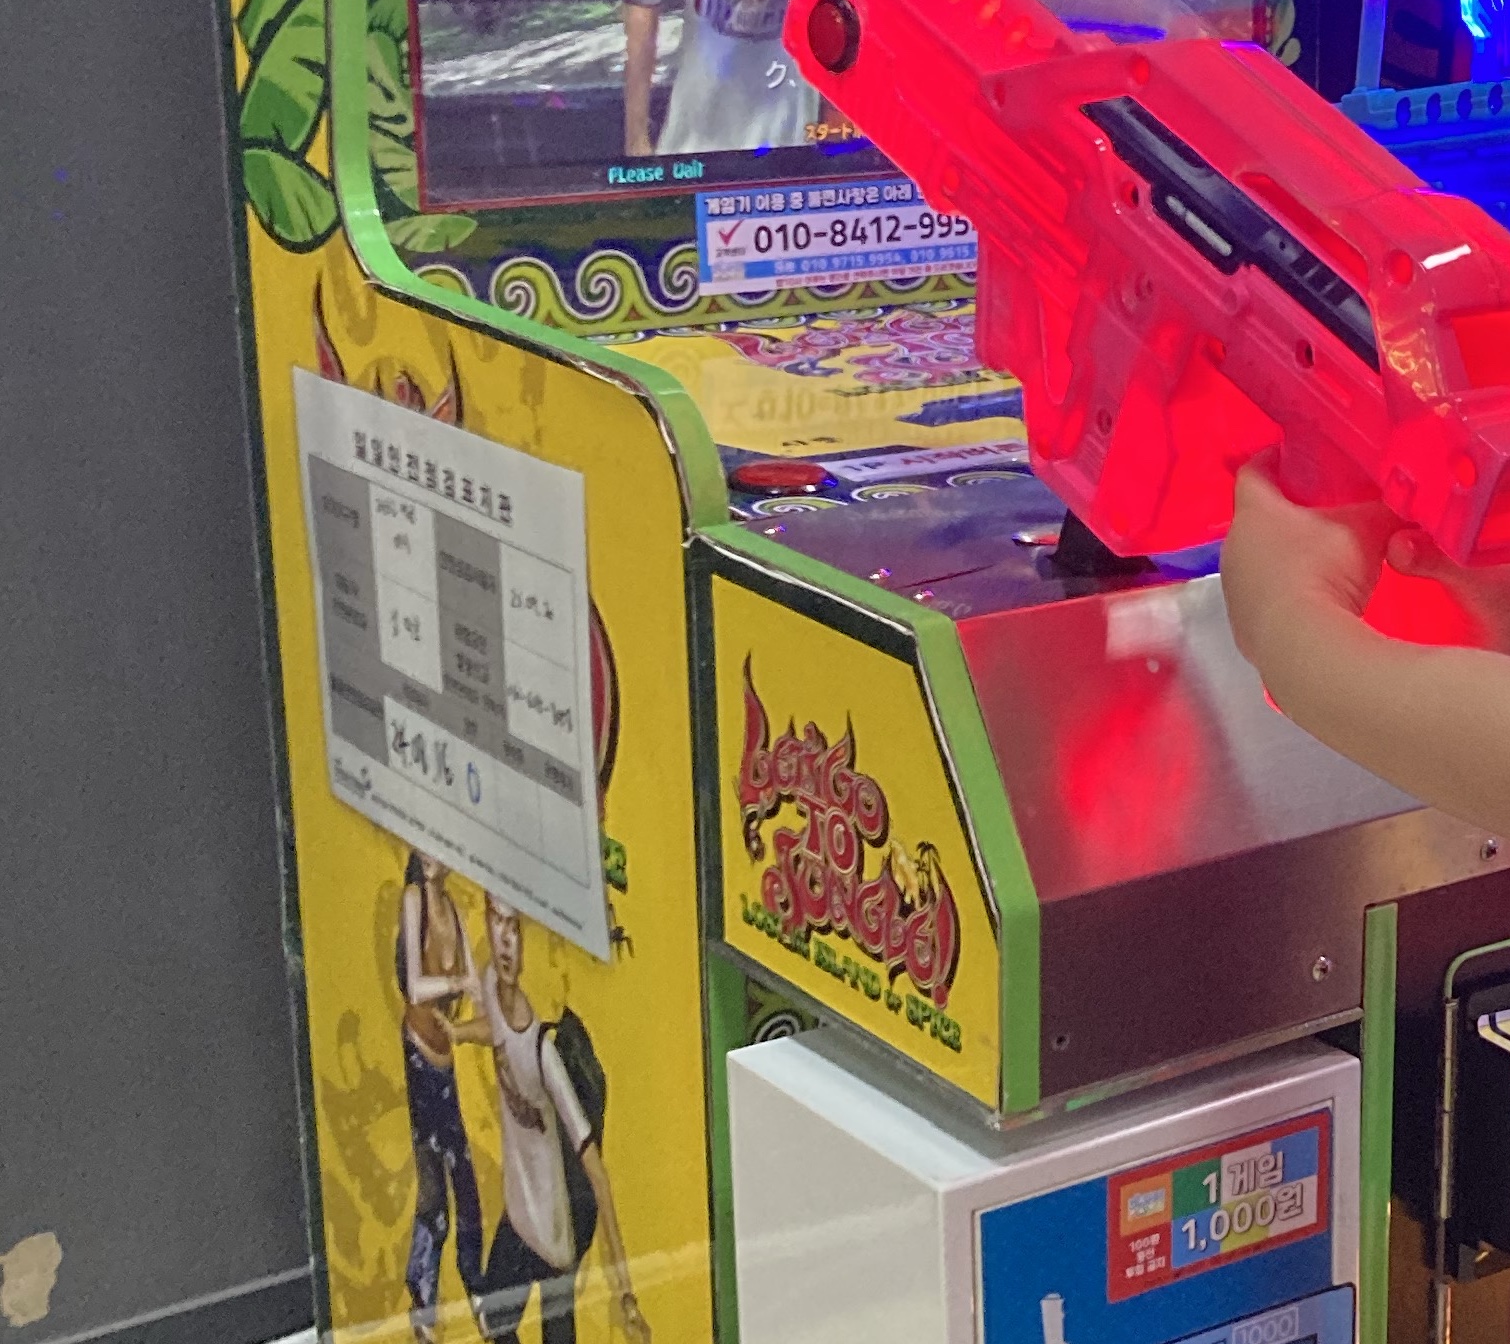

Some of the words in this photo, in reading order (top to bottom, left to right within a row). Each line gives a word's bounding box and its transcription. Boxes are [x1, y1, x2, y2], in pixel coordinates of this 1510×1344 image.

[705, 195, 751, 216] 게임기
[755, 193, 786, 213] 이용
[754, 212, 977, 254] 010-8412-995
[799, 796, 860, 874] TO
[813, 938, 882, 1002] ISLAND
[1202, 1171, 1218, 1204] 1
[1227, 1150, 1284, 1196] 게임
[1181, 1182, 1304, 1253] 1,000원
